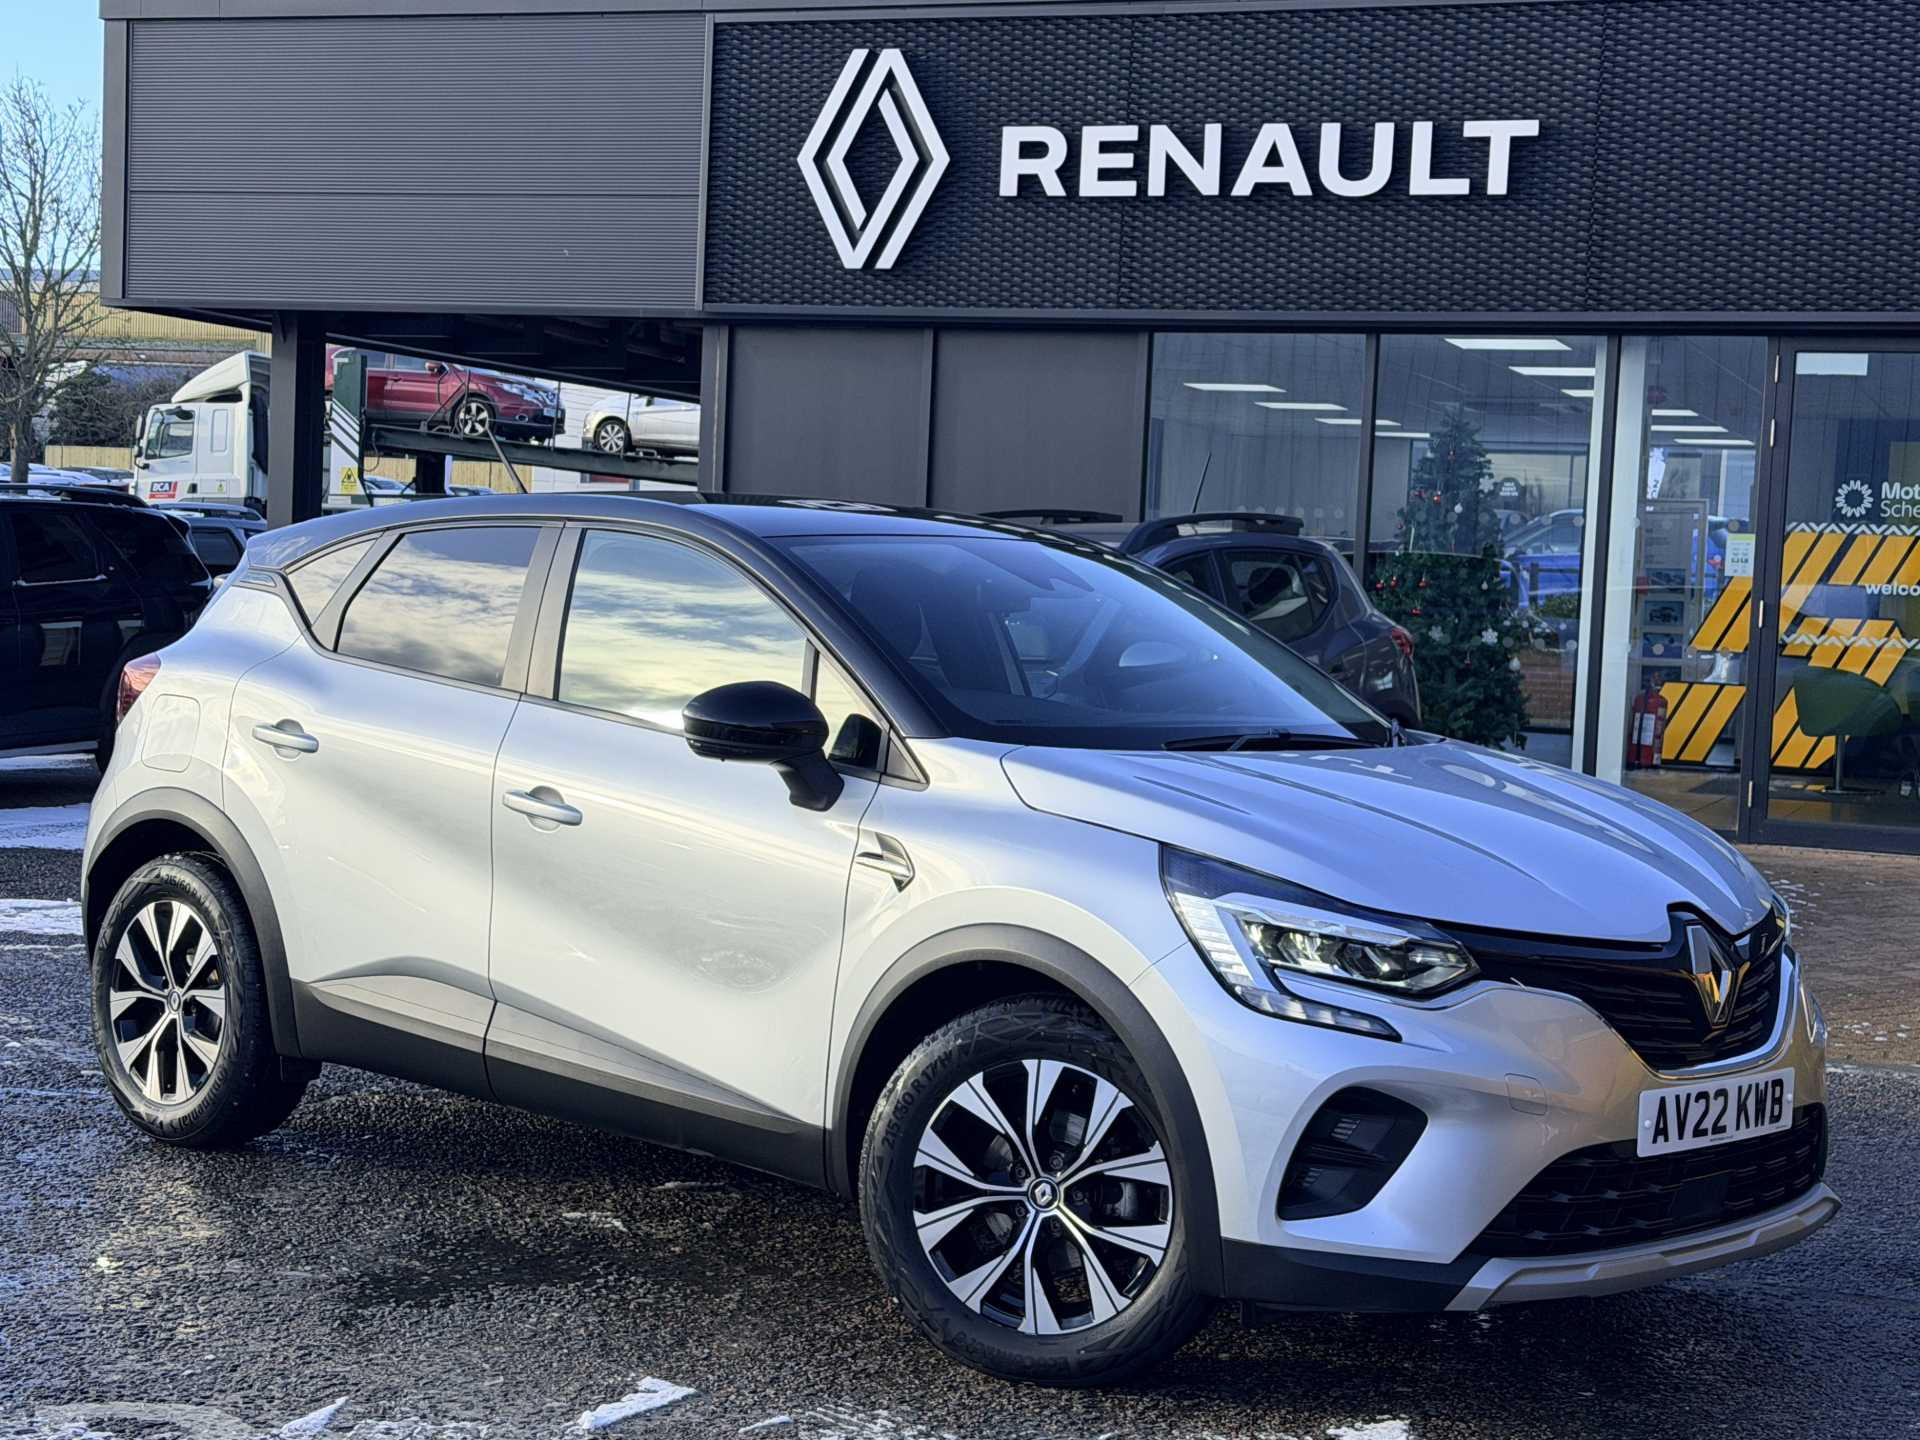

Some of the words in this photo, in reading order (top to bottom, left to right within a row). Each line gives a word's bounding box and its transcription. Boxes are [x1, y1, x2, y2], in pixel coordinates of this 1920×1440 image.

[998, 118, 1540, 198] RENAULT
[1881, 481, 1920, 500] Mot
[1880, 500, 1920, 518] Sche
[1864, 582, 1920, 596] welco
[1651, 1087, 1729, 1145] AV22
[1735, 1078, 1784, 1131] KWB
